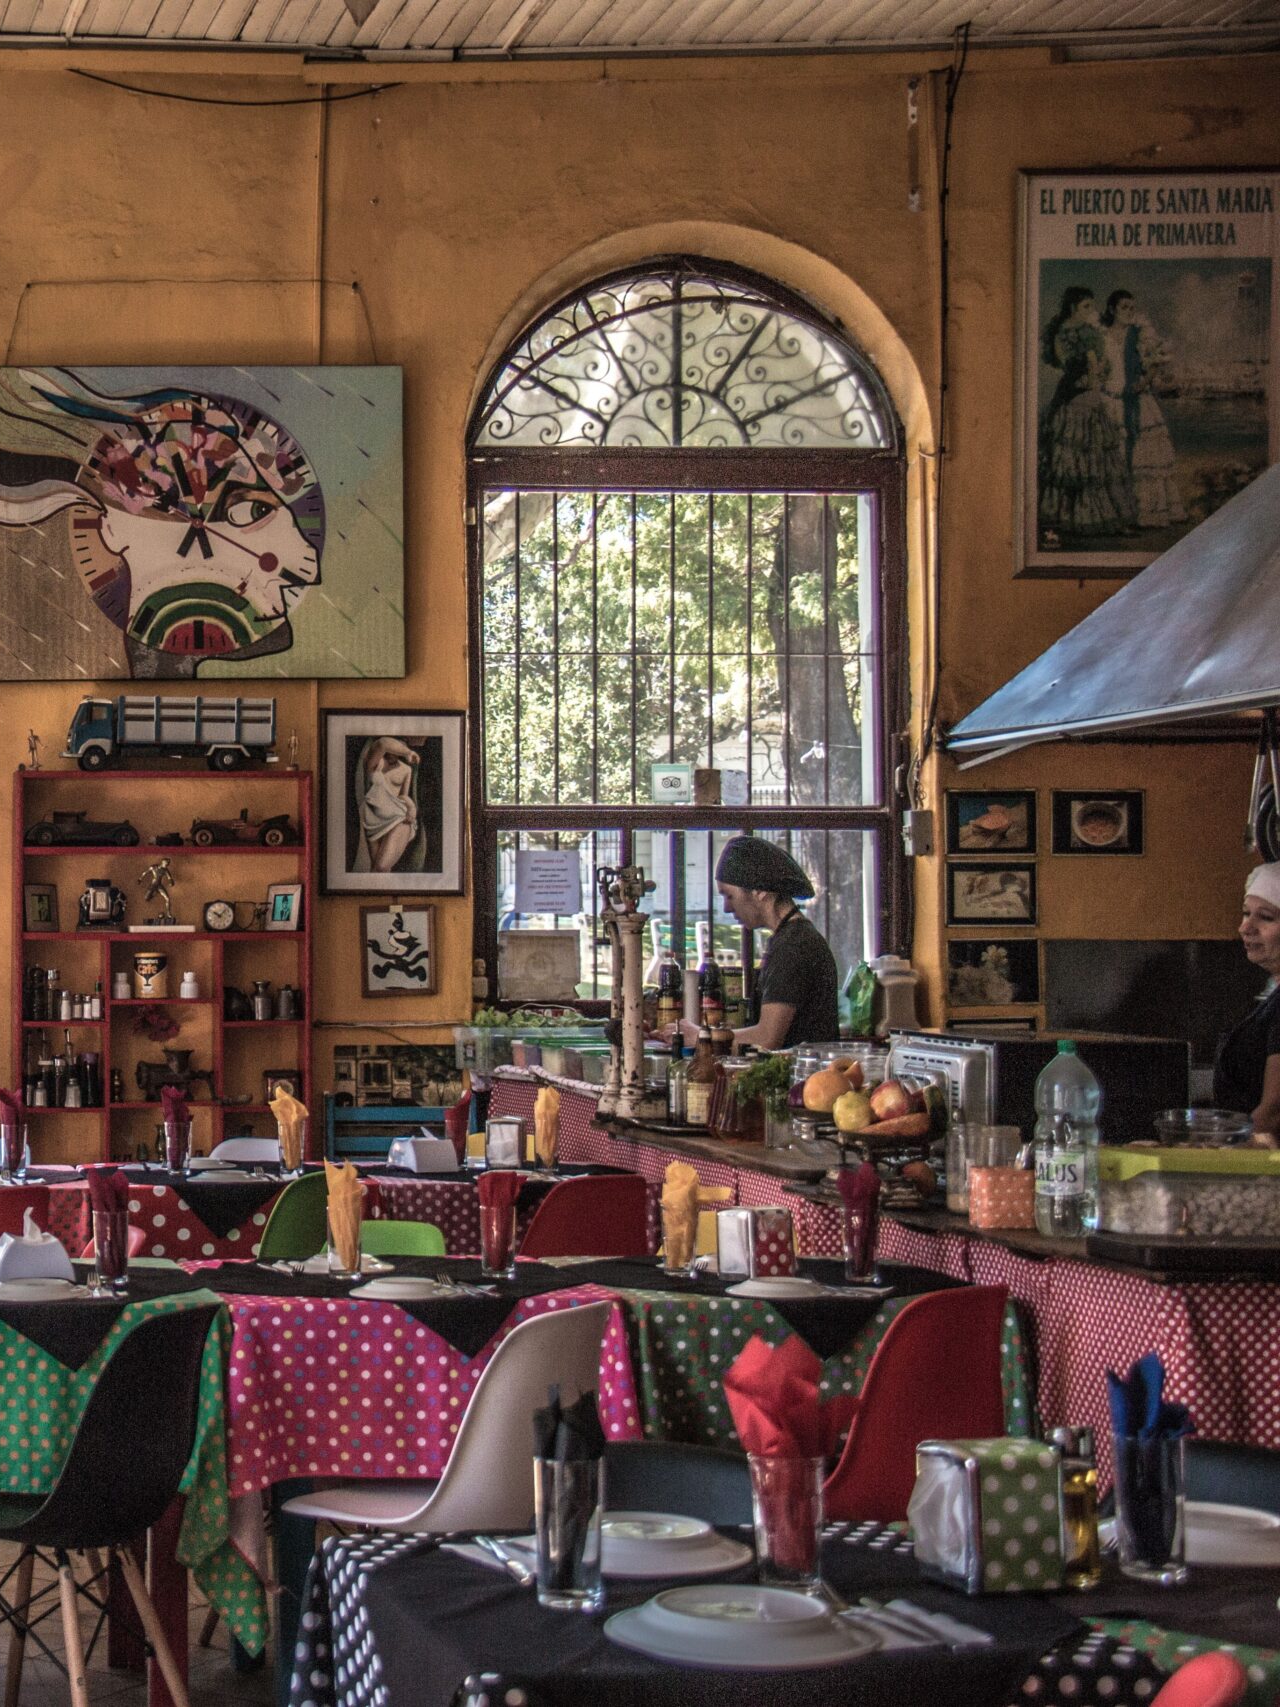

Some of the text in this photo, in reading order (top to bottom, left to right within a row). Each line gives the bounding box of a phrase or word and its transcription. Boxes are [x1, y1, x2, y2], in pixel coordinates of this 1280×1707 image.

[1040, 187, 1273, 214] EL PUERTO DE SANTA MARIA
[1076, 222, 1236, 246] FERIA DE PRIMAVERA
[1035, 1162, 1078, 1184] ALUS
